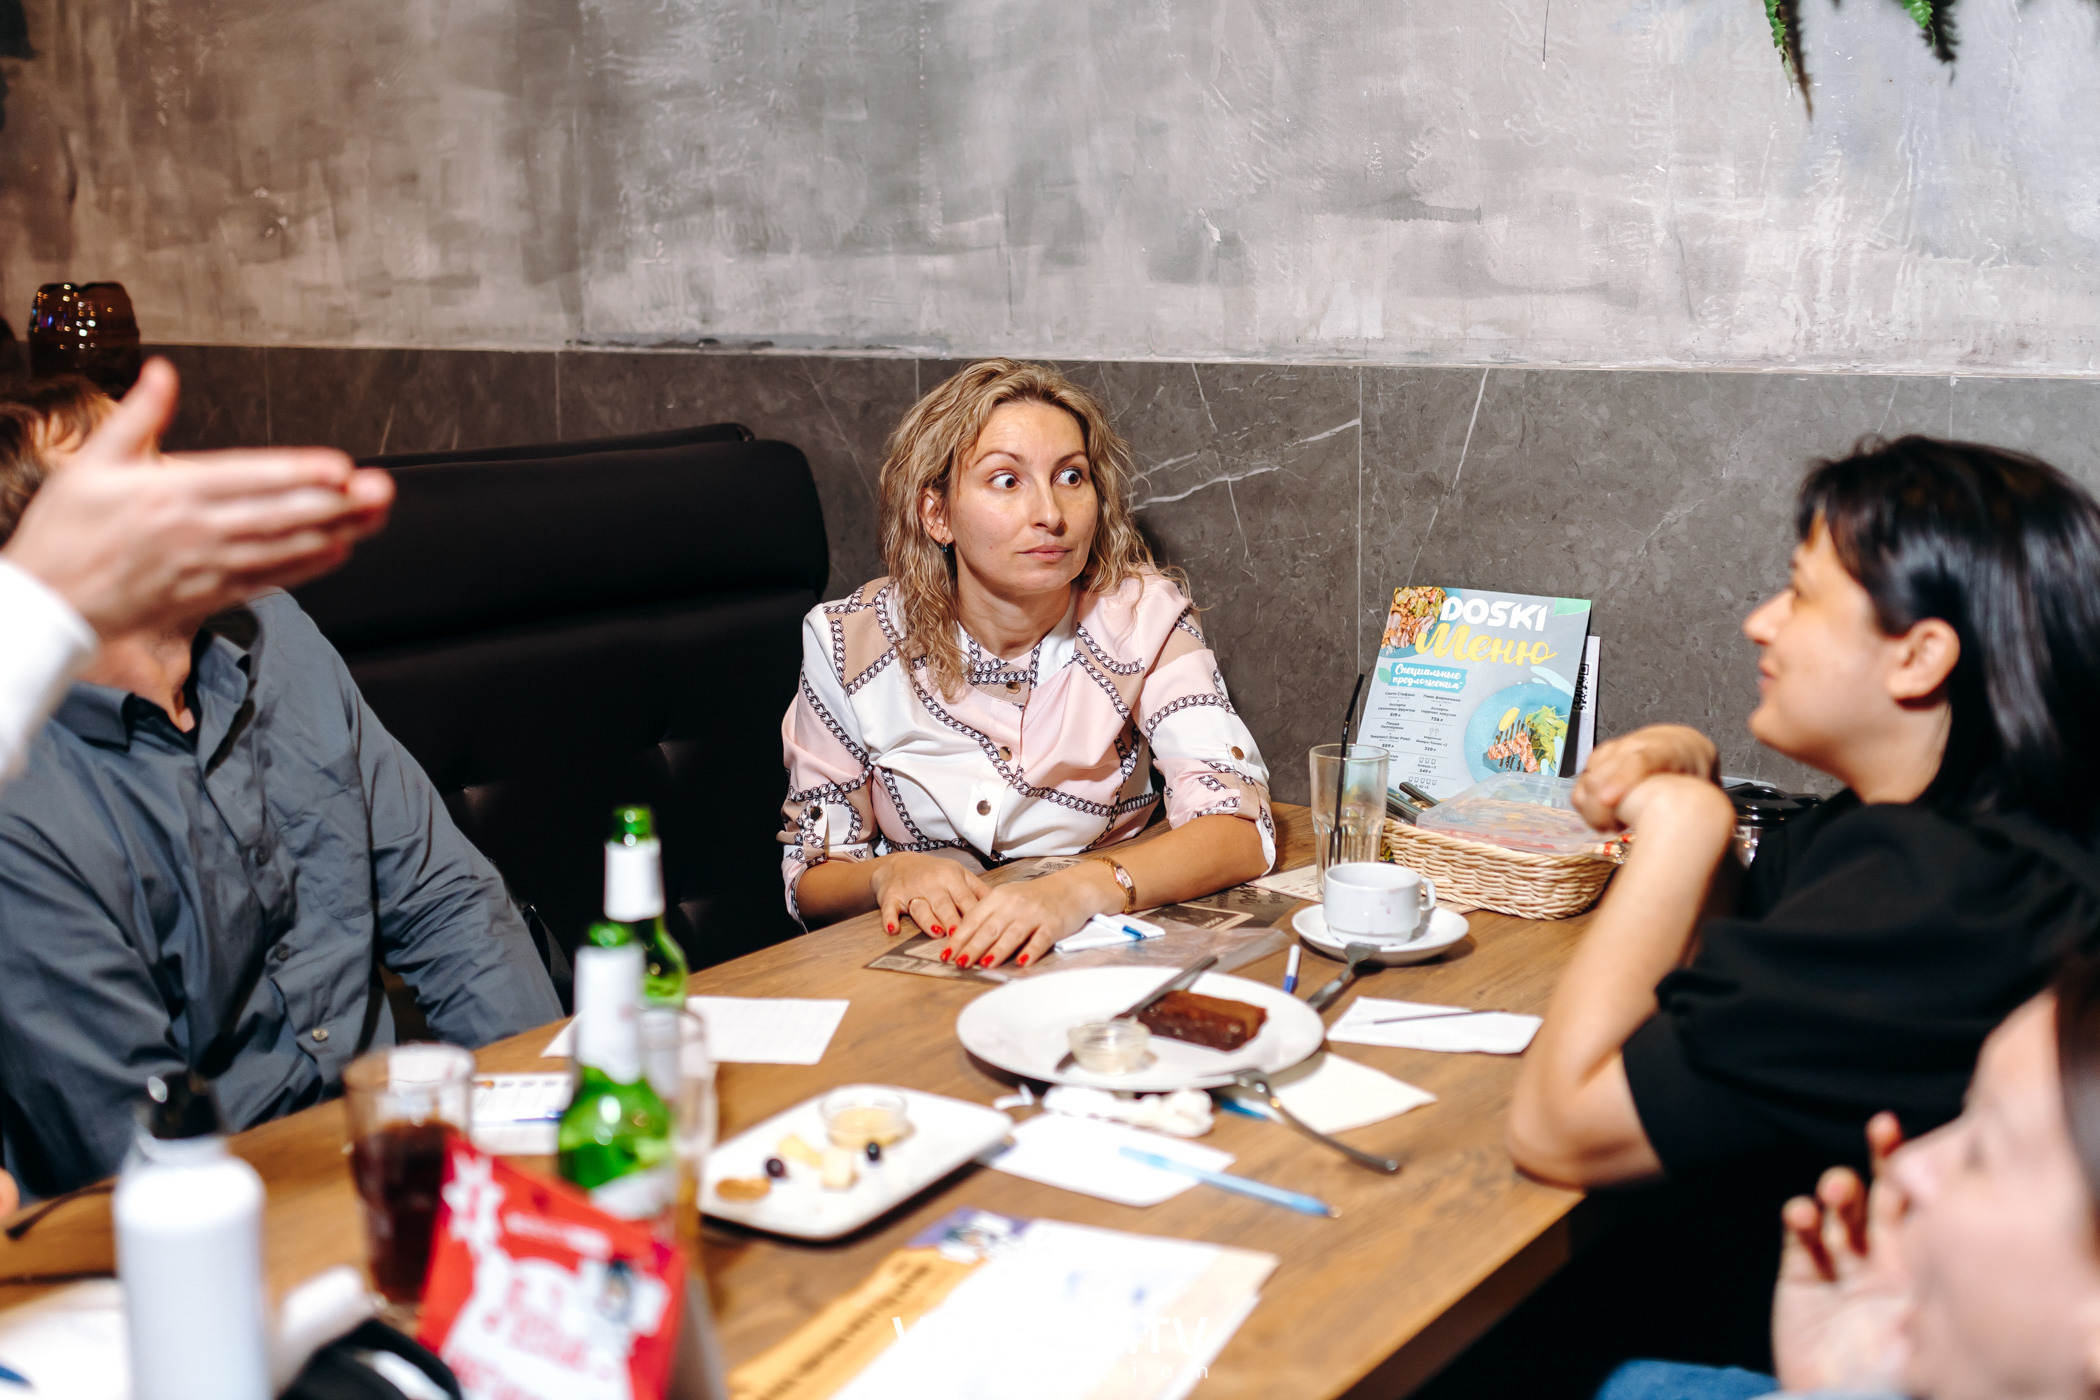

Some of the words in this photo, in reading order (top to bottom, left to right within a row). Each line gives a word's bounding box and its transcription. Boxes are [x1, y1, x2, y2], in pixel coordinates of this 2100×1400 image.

[1440, 596, 1548, 631] DOSKI
[1415, 622, 1557, 666] Меню
[1394, 663, 1462, 680] Специальные
